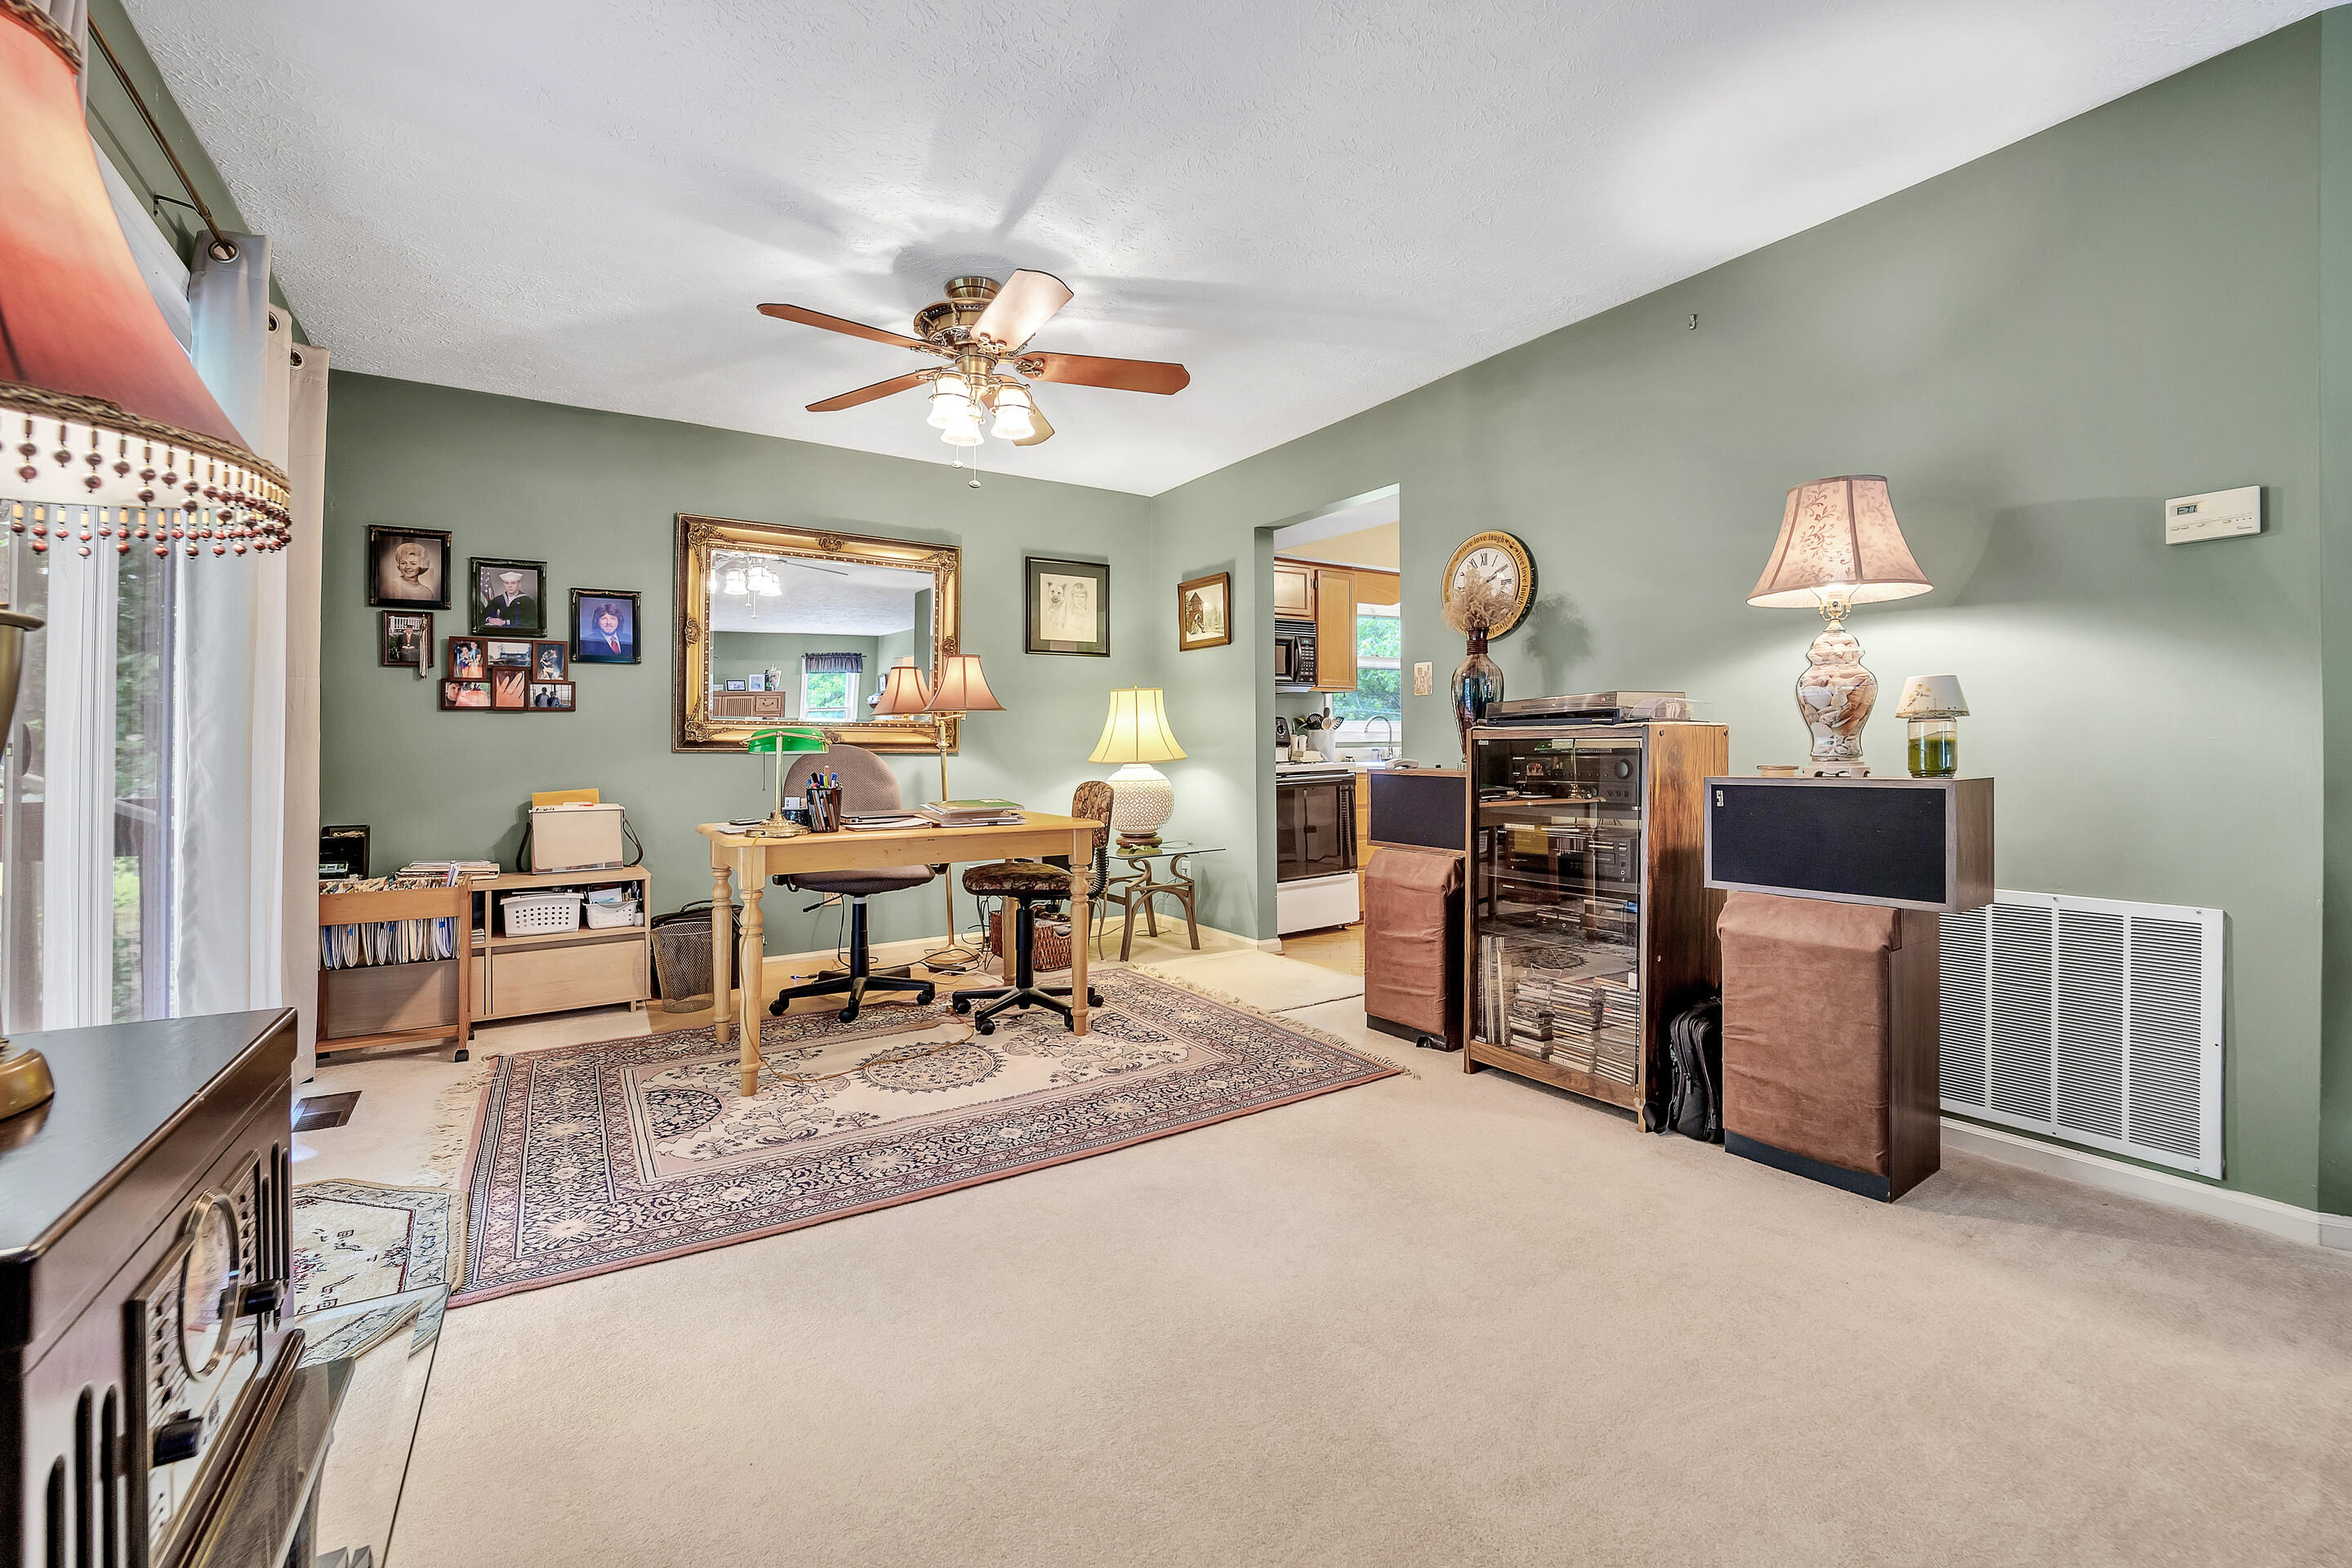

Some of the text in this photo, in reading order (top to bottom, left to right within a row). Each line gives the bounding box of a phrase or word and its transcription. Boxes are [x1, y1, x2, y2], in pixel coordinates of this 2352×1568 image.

[1462, 533, 1505, 551] live love laugh
[1480, 553, 1488, 567] XII
[1517, 551, 1525, 565] live
[1517, 585, 1528, 605] laugh
